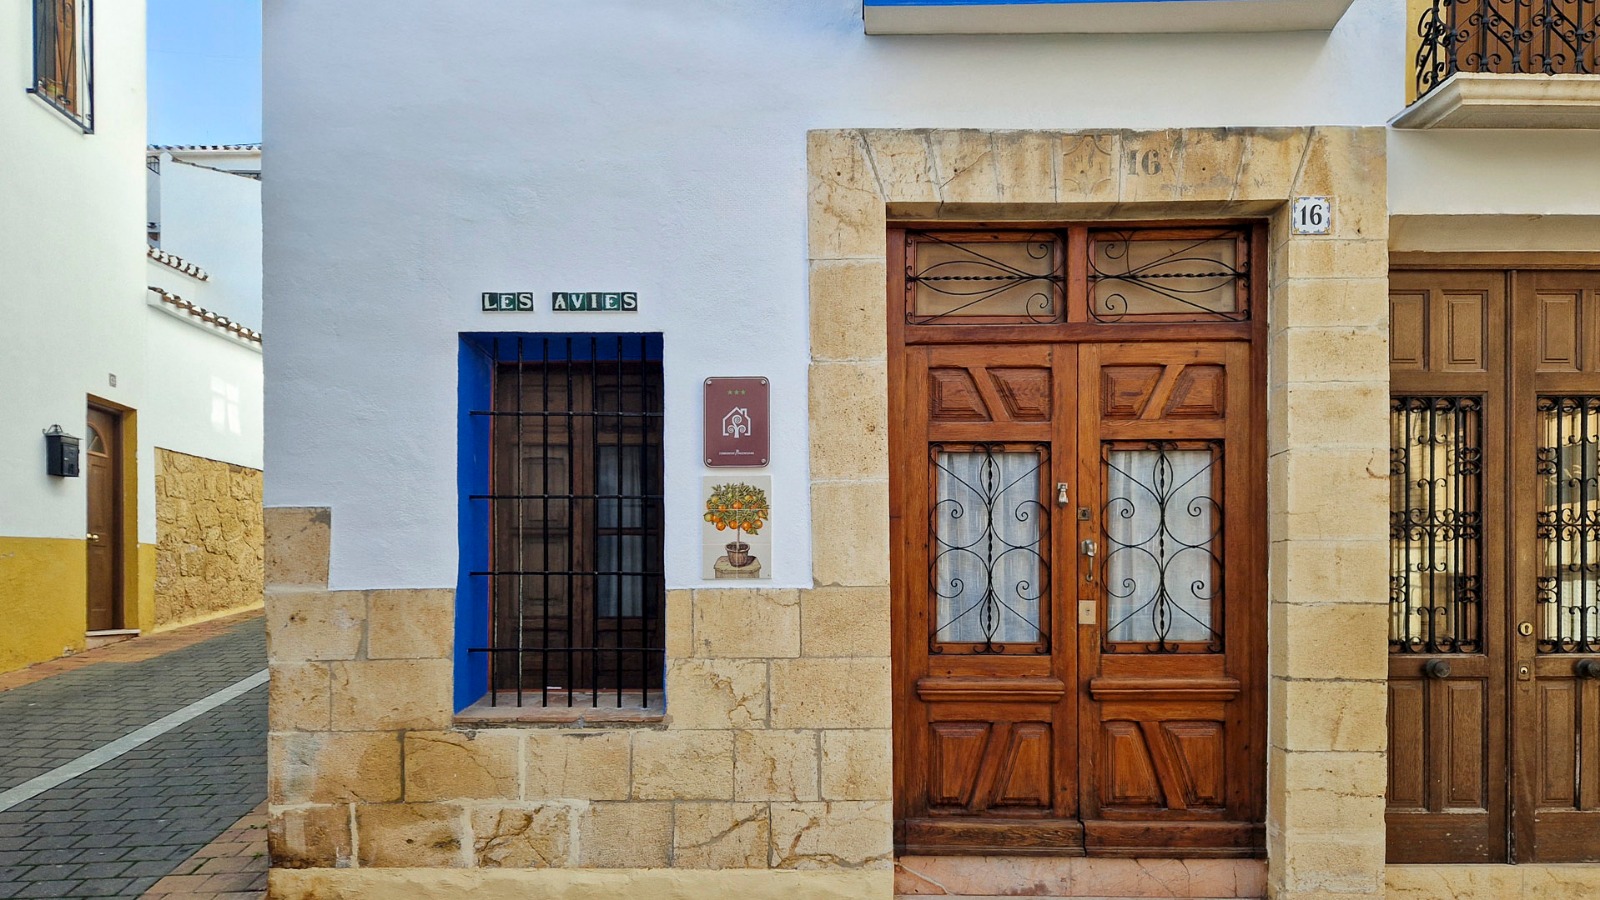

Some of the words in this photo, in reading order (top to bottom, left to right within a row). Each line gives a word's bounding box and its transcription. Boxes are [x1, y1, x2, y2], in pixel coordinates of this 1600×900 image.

[1127, 149, 1162, 176] 16
[1300, 204, 1323, 226] 16
[484, 293, 532, 310] LES
[554, 293, 636, 310] AVIES
